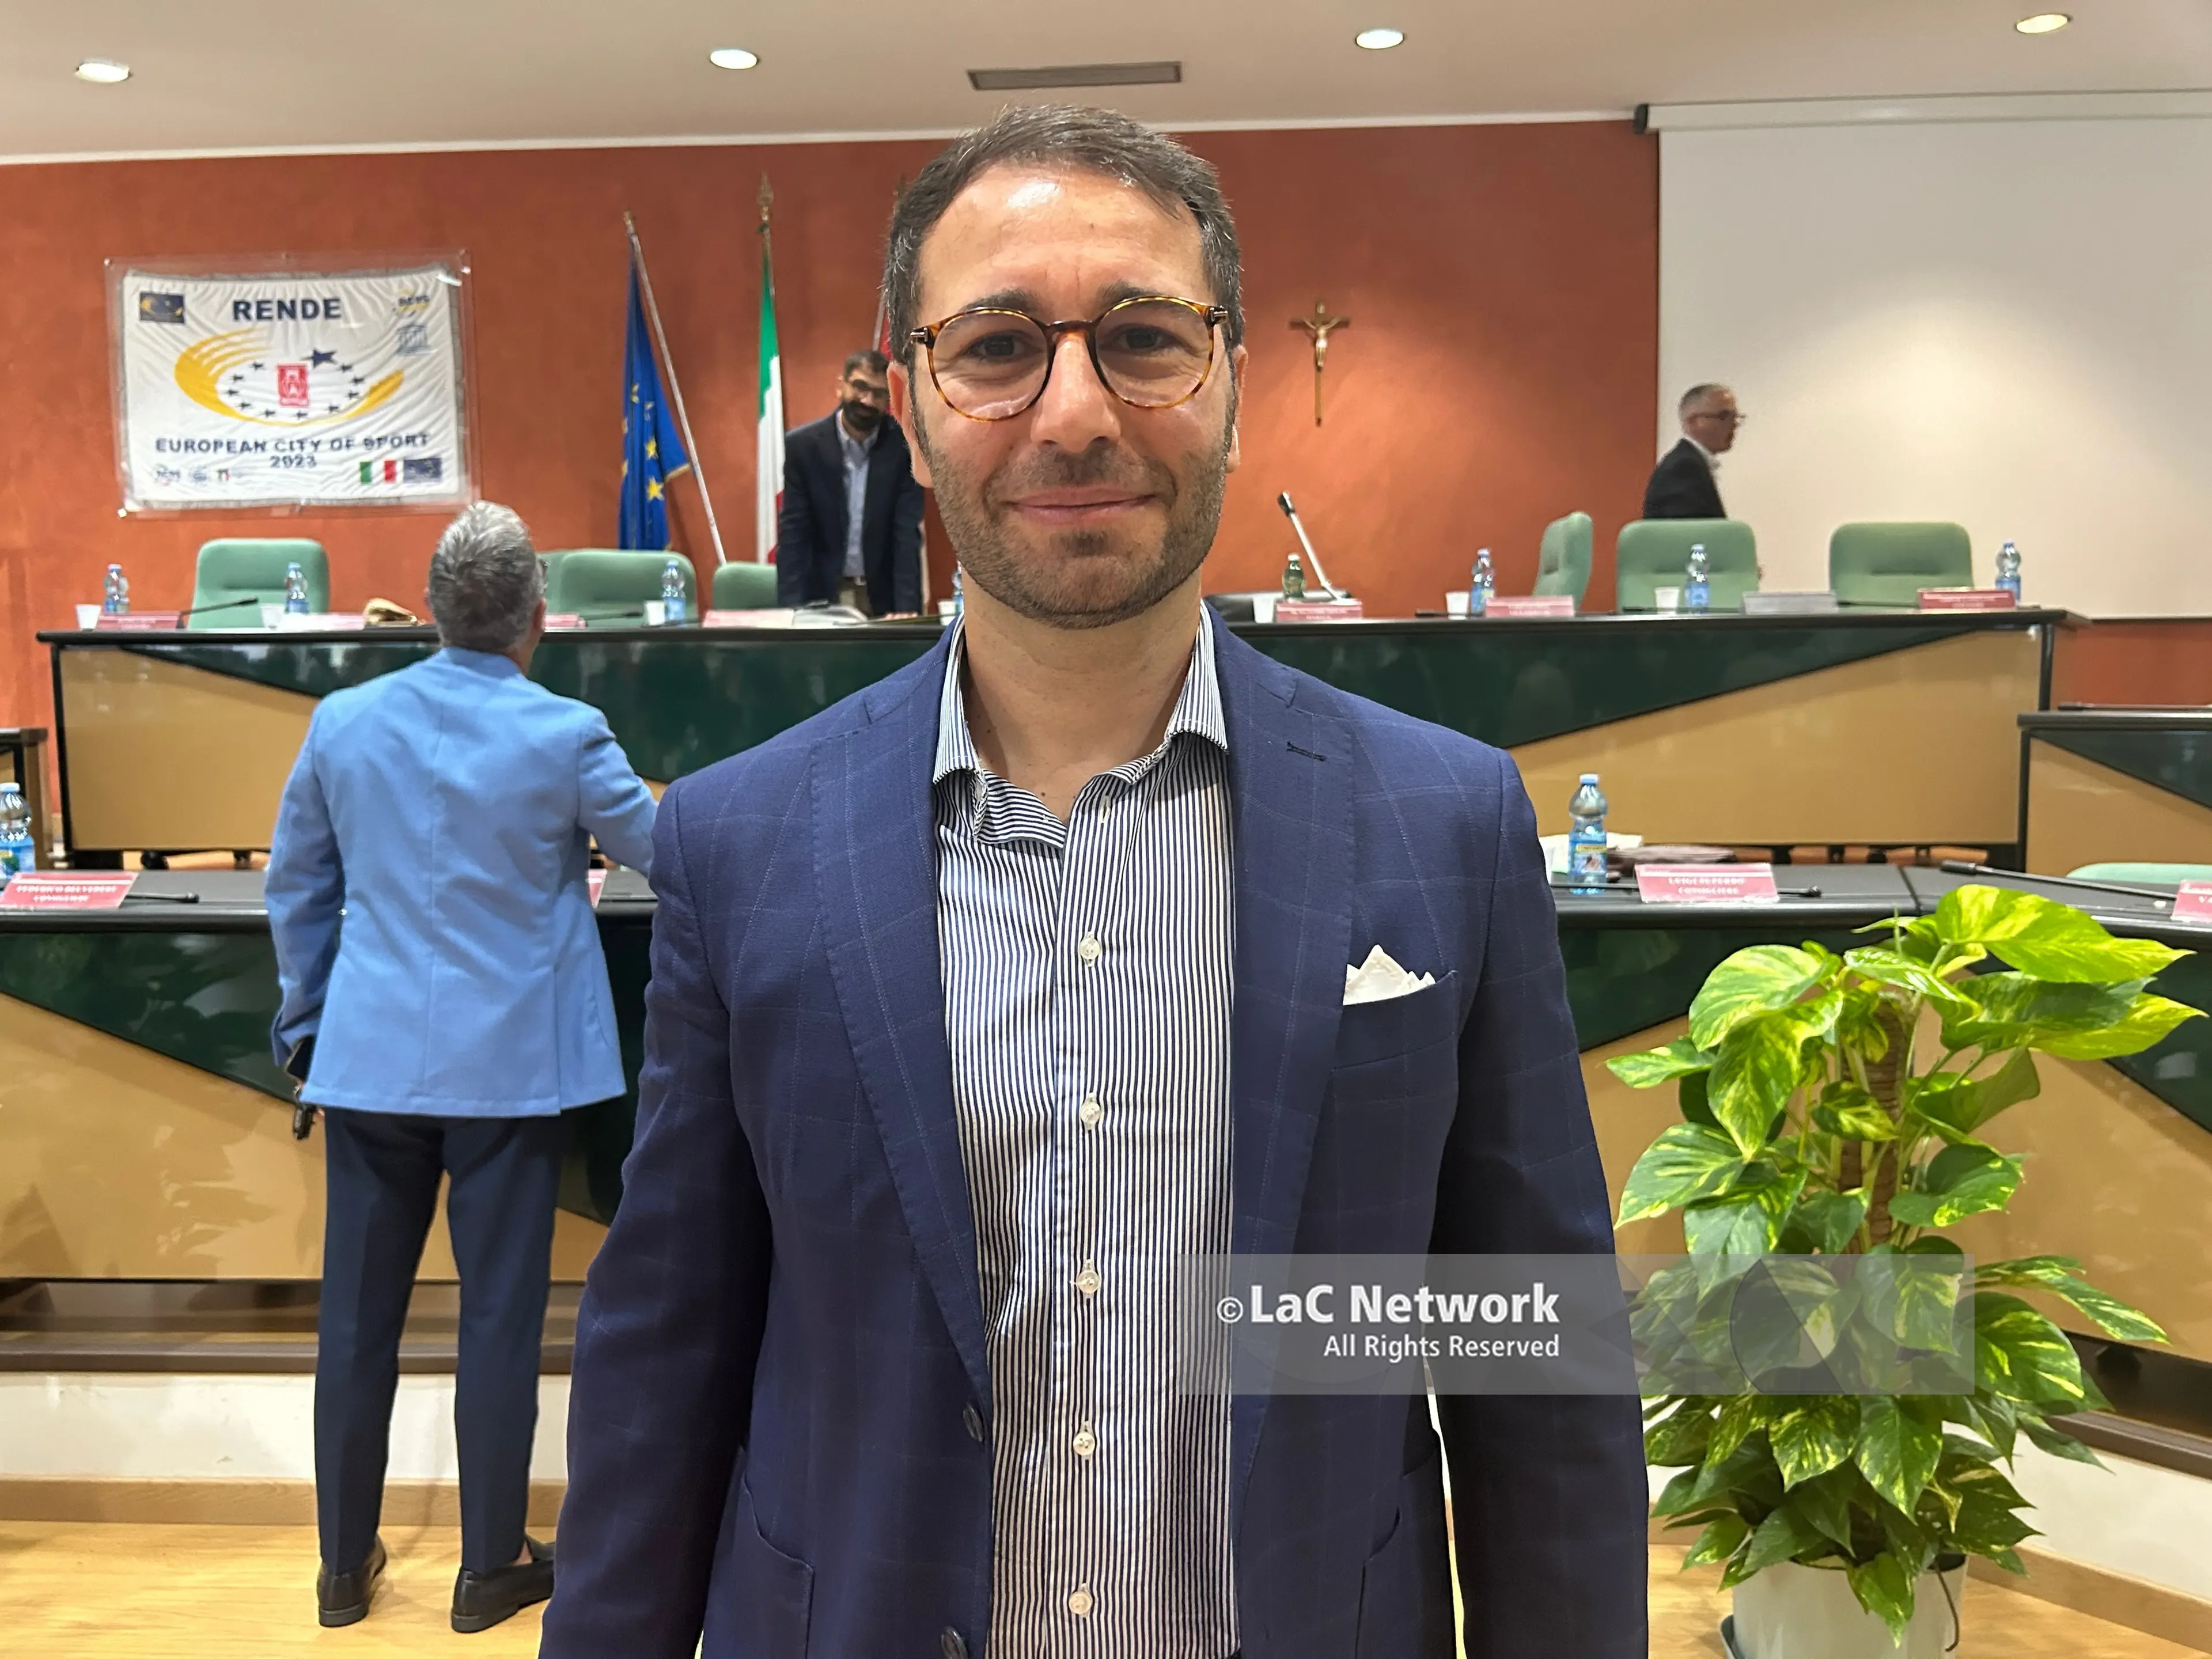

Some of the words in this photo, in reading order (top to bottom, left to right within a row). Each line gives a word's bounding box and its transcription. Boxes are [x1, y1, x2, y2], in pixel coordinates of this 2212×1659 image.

[233, 297, 342, 321] RENDE
[156, 438, 267, 454] EUROPEAN
[274, 438, 322, 453] CITY
[330, 437, 354, 451] OF
[363, 433, 429, 450] SPORT
[270, 455, 317, 469] 2023
